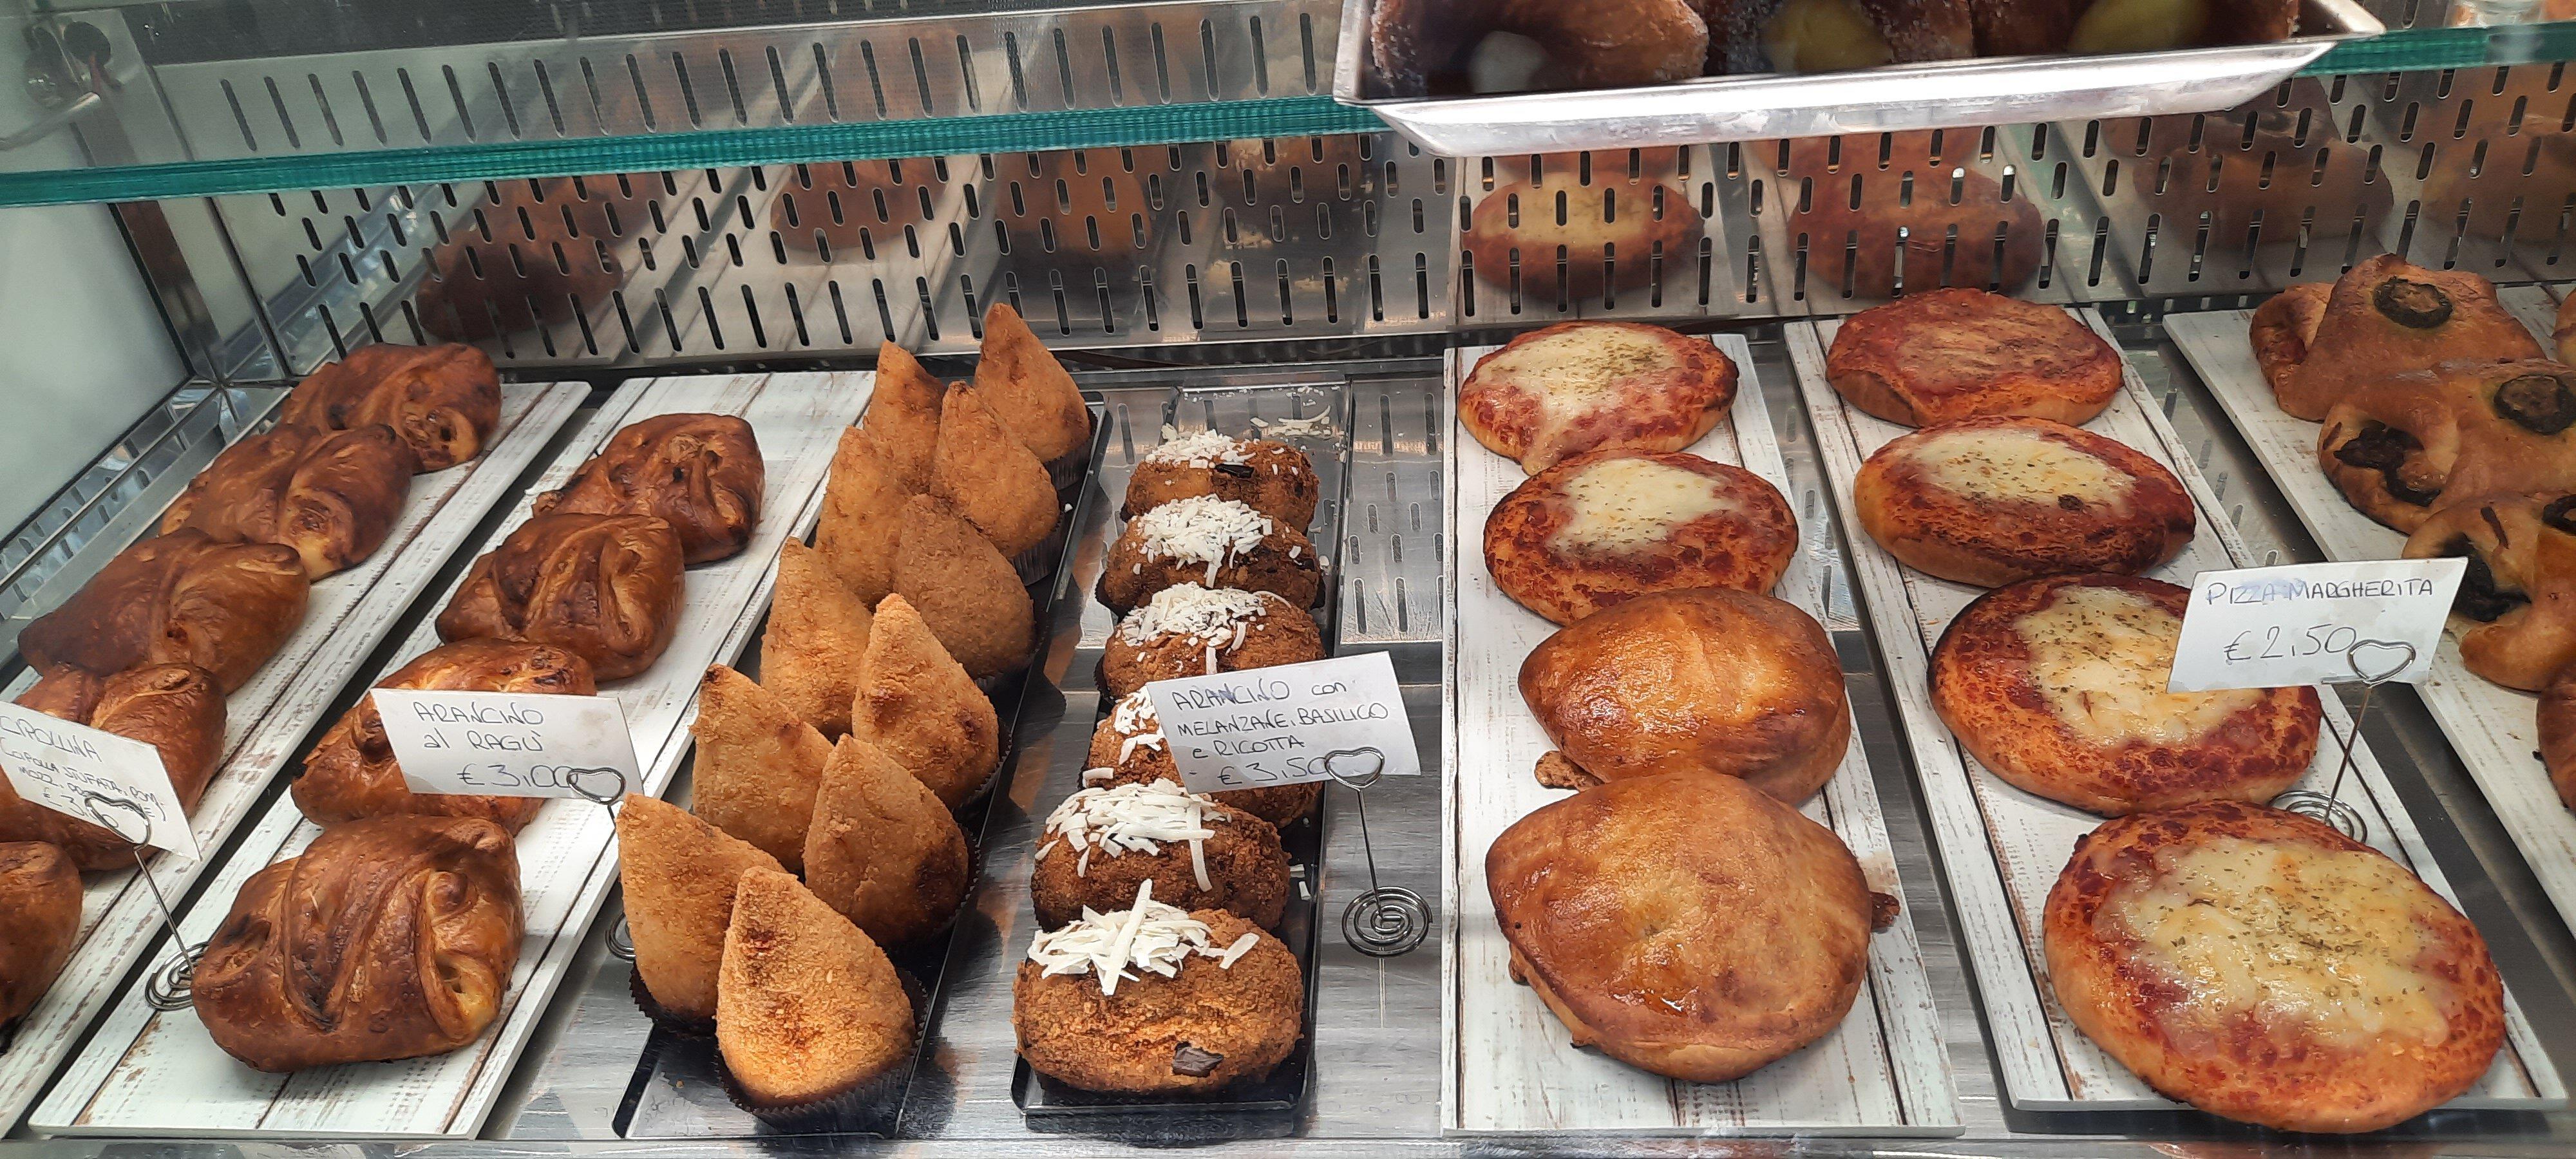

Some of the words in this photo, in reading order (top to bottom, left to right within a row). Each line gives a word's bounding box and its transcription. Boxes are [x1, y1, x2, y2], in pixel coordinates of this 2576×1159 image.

[2206, 582, 2275, 605] PIZZA
[2288, 578, 2433, 600] MARGHERITA
[1171, 677, 1291, 711] ARANCINO
[1311, 682, 1348, 696] con
[412, 701, 544, 725] ARANCINO
[1296, 702, 1388, 726] BASILICO
[423, 728, 451, 749] al
[1192, 748, 1209, 759] e
[1213, 735, 1305, 757] RICOTTA
